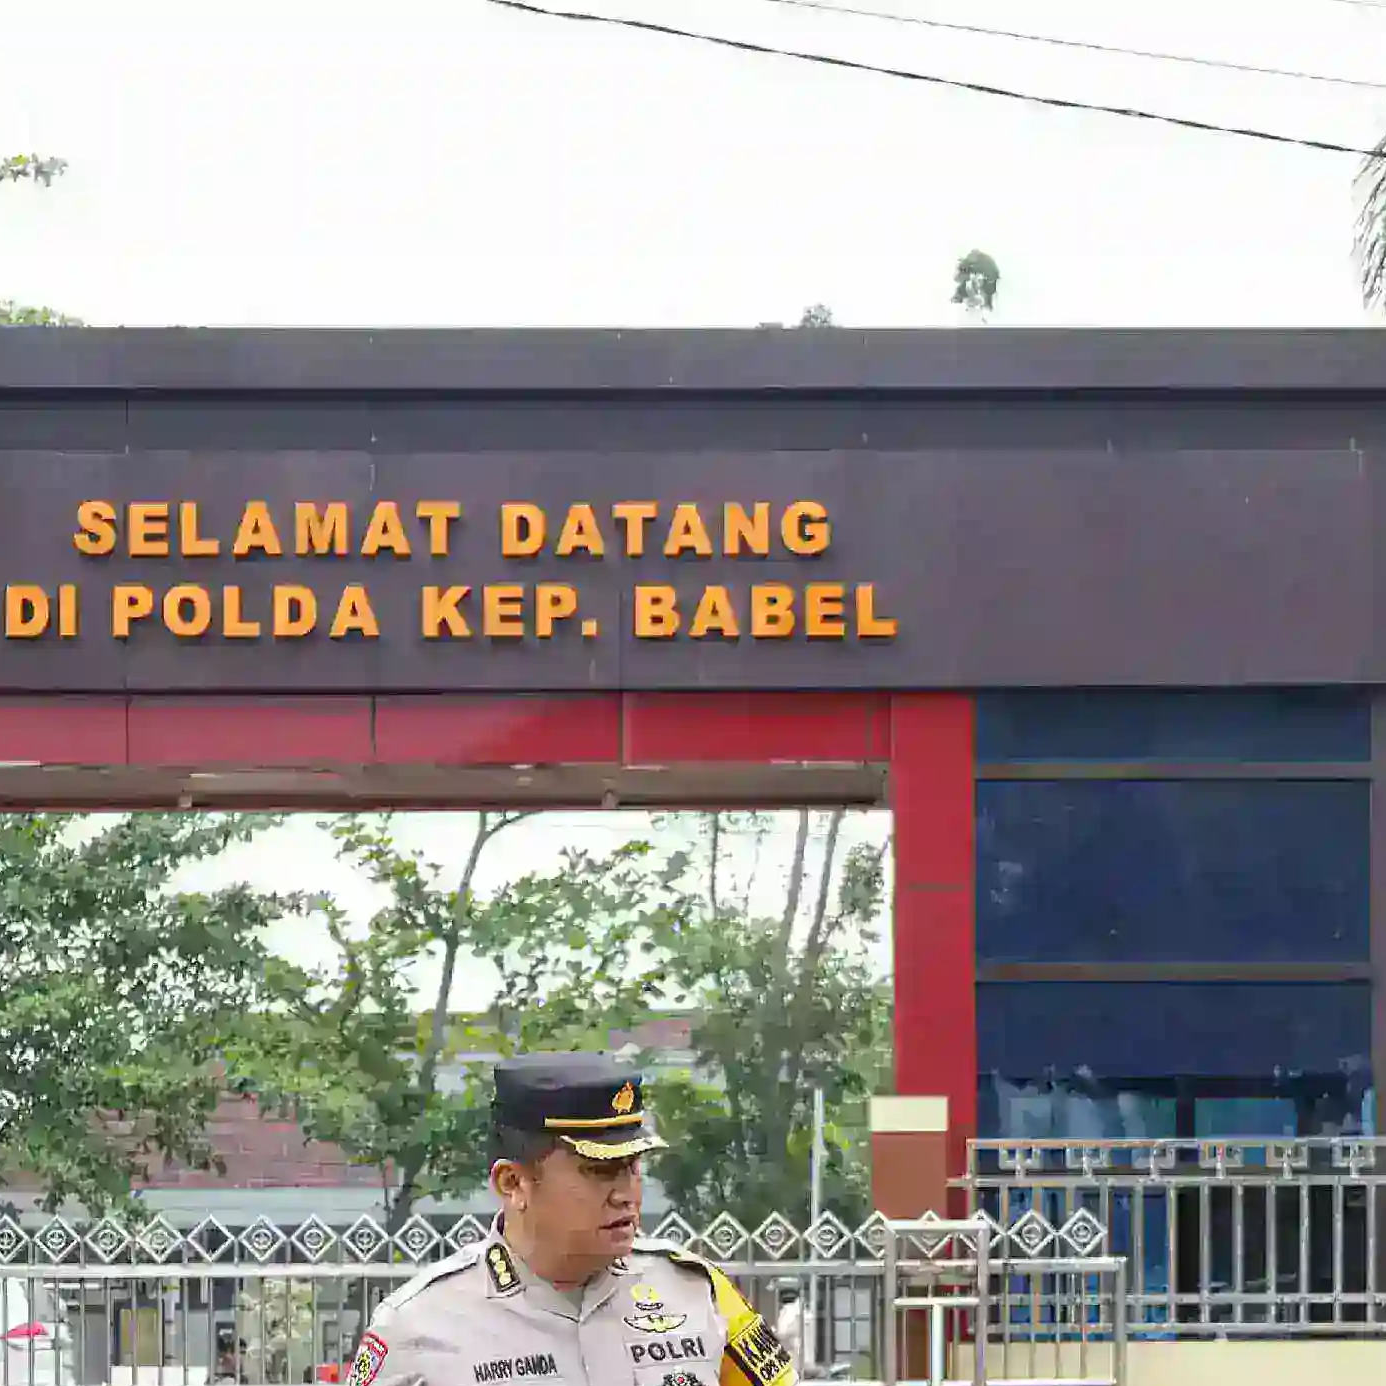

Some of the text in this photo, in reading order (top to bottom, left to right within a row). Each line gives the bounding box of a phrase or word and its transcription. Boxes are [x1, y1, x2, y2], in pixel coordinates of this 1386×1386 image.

[72, 499, 832, 557] SELAMAT DATANG
[4, 582, 901, 638] DI POLDA KEP. BABEL
[473, 1352, 558, 1384] HARRY GANDA
[629, 1335, 706, 1363] POLRI
